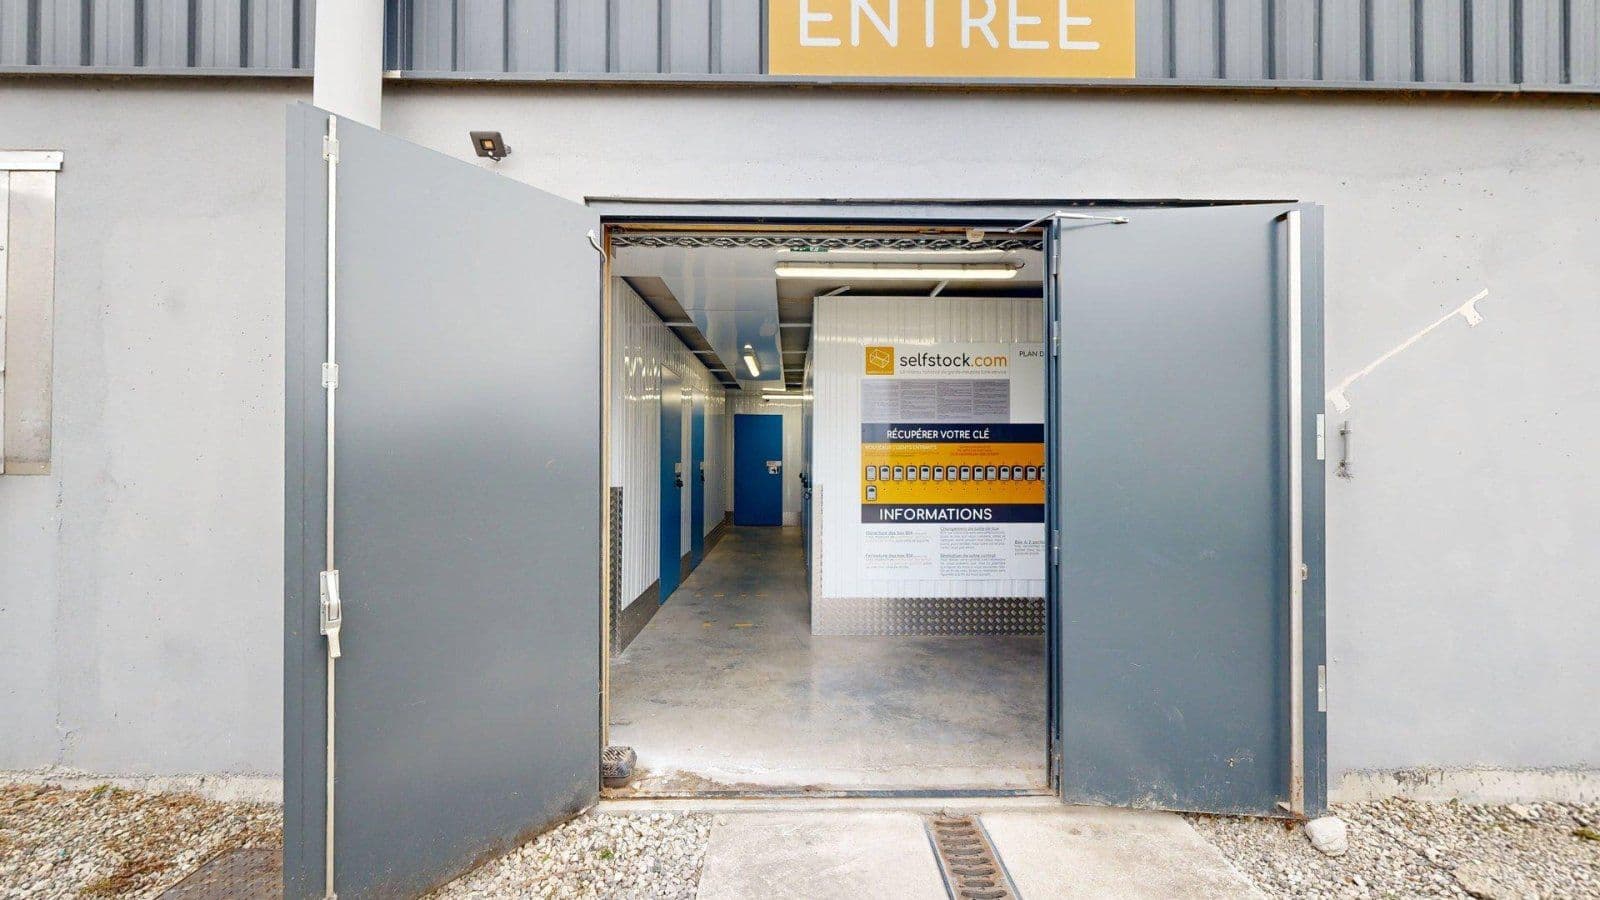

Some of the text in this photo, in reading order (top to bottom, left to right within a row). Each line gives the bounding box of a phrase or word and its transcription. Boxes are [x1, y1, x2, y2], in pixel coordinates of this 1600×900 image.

[900, 353, 1007, 367] selfstock.com
[887, 429, 990, 439] RÉCUPÉRER VOTRE CLÉ
[880, 508, 993, 521] INFORMATIONS
